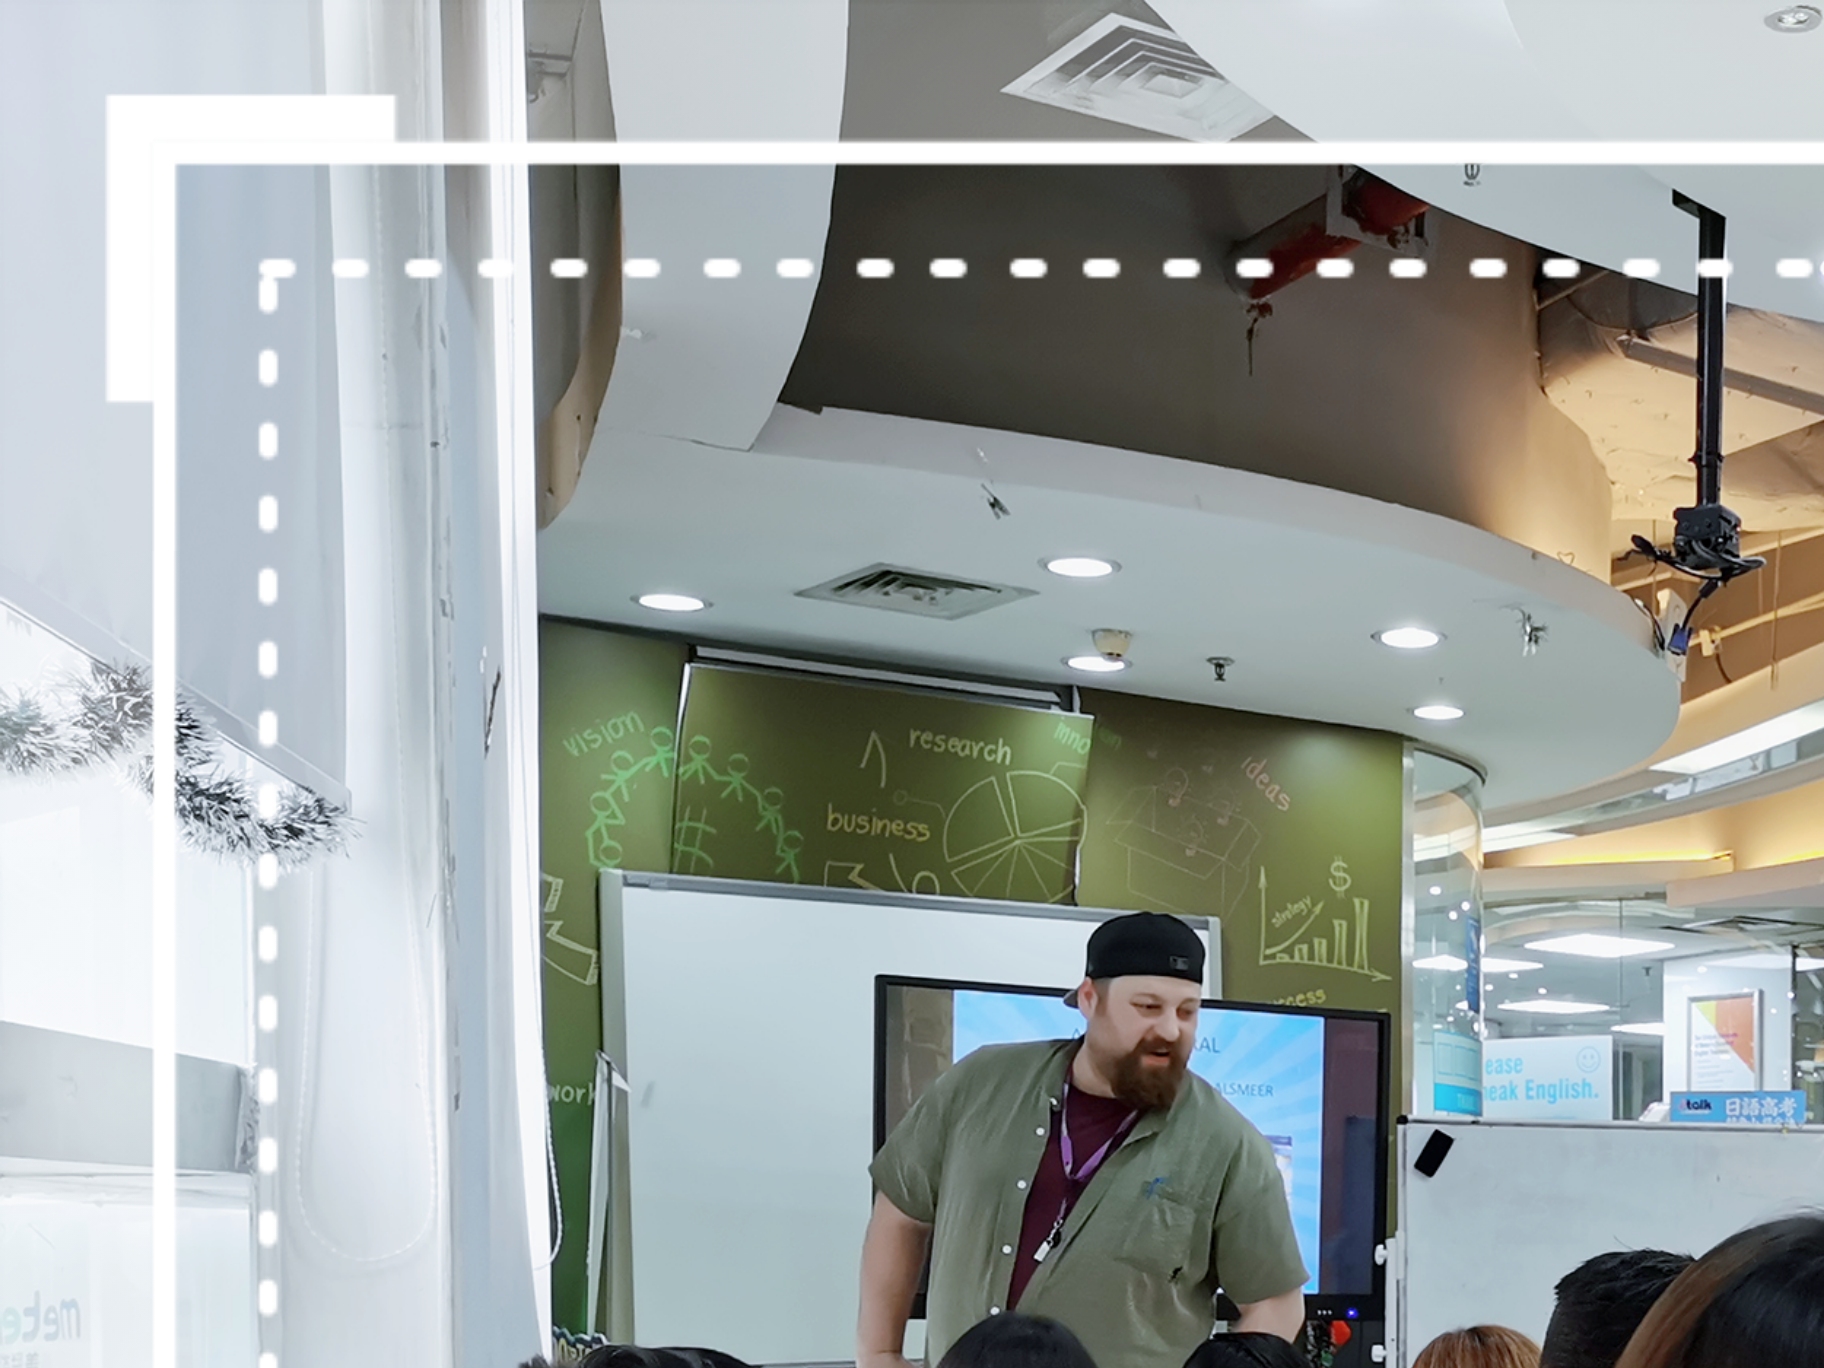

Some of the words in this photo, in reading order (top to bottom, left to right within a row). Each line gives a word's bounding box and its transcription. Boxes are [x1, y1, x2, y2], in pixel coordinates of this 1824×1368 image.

[563, 711, 644, 757] vision
[909, 728, 1011, 765] research
[1241, 756, 1291, 812] ideas
[826, 803, 931, 842] business
[1525, 1078, 1600, 1105] English.
